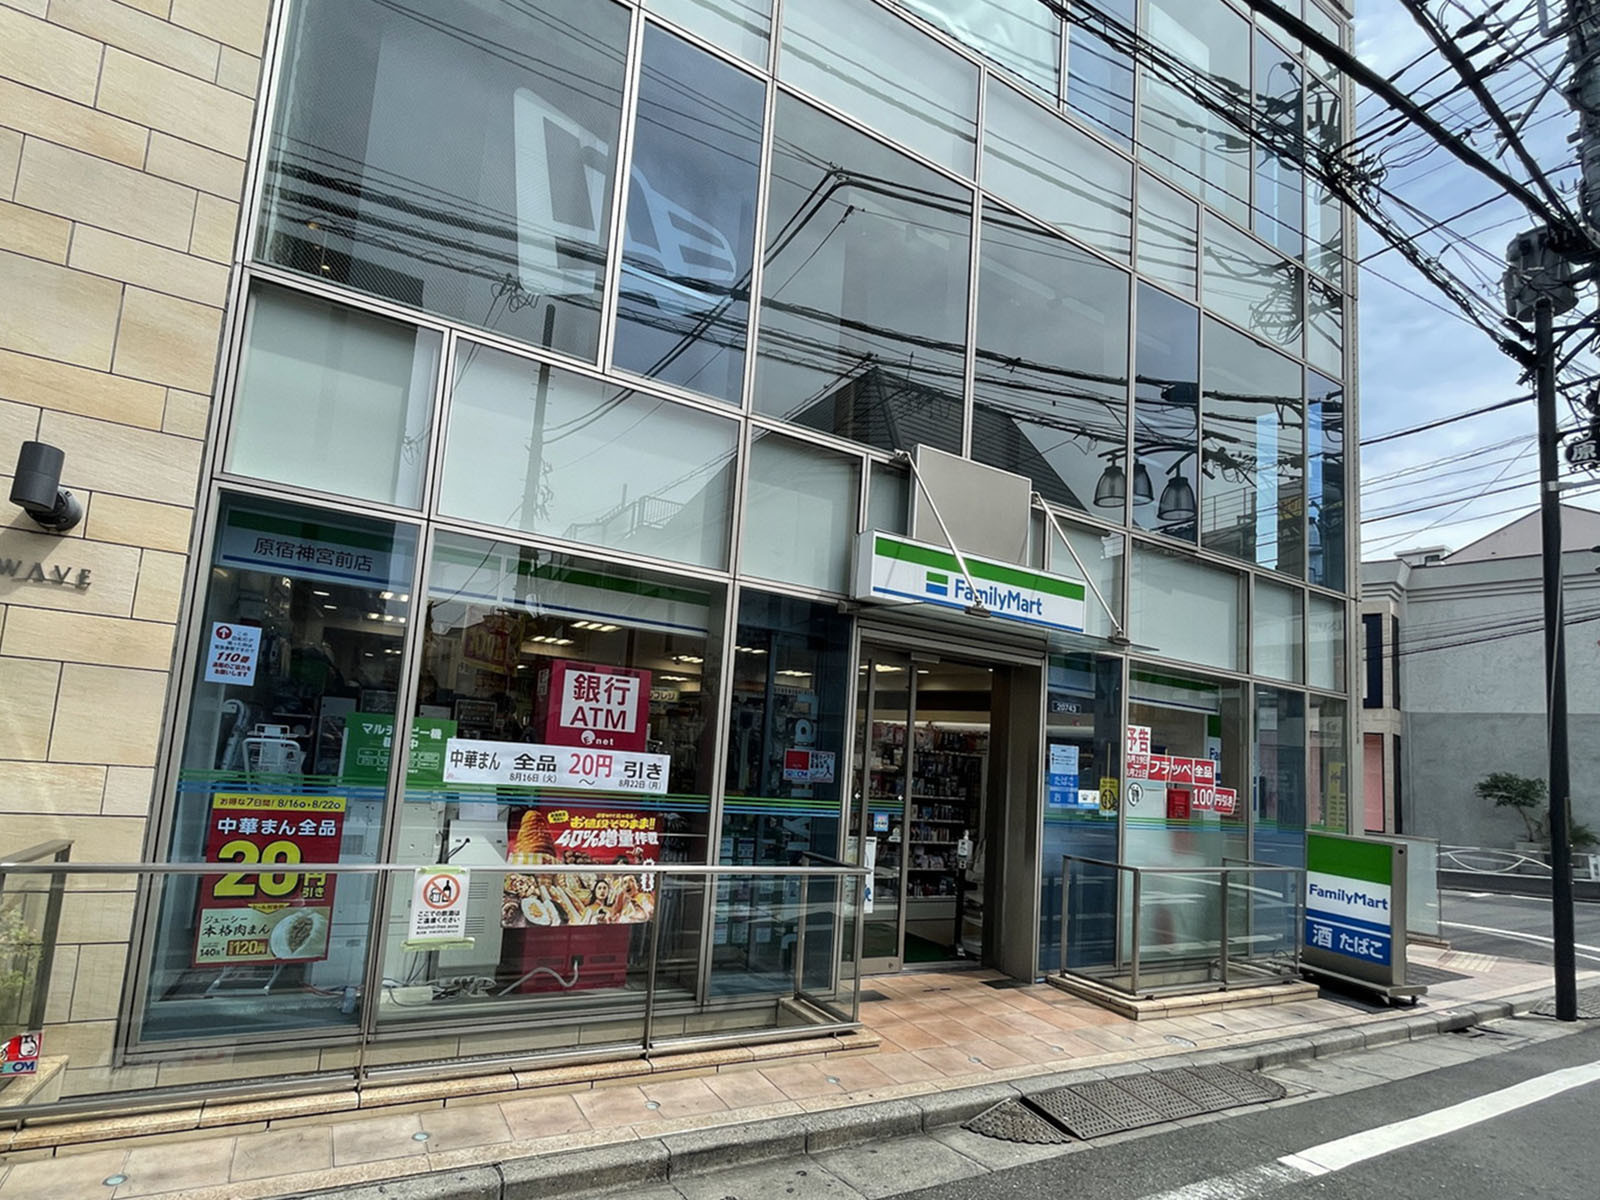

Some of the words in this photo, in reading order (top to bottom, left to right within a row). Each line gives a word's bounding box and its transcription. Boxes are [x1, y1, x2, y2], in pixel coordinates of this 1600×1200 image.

[253, 537, 373, 573] 原宿神宮前店
[0, 558, 91, 589] WAVE
[955, 579, 1043, 616] FamilyMart
[573, 673, 631, 706] 銀行
[569, 706, 627, 730] ATM
[450, 749, 501, 771] 中華まん
[513, 753, 557, 773] 全品
[569, 753, 613, 778] 20円
[623, 761, 663, 780] 引き
[218, 817, 337, 837] 中華まん全品
[1309, 883, 1389, 911] FamilyMart
[202, 923, 271, 938] 本格肉まん
[1312, 924, 1333, 949] 酒
[1339, 932, 1384, 959] たばこ
